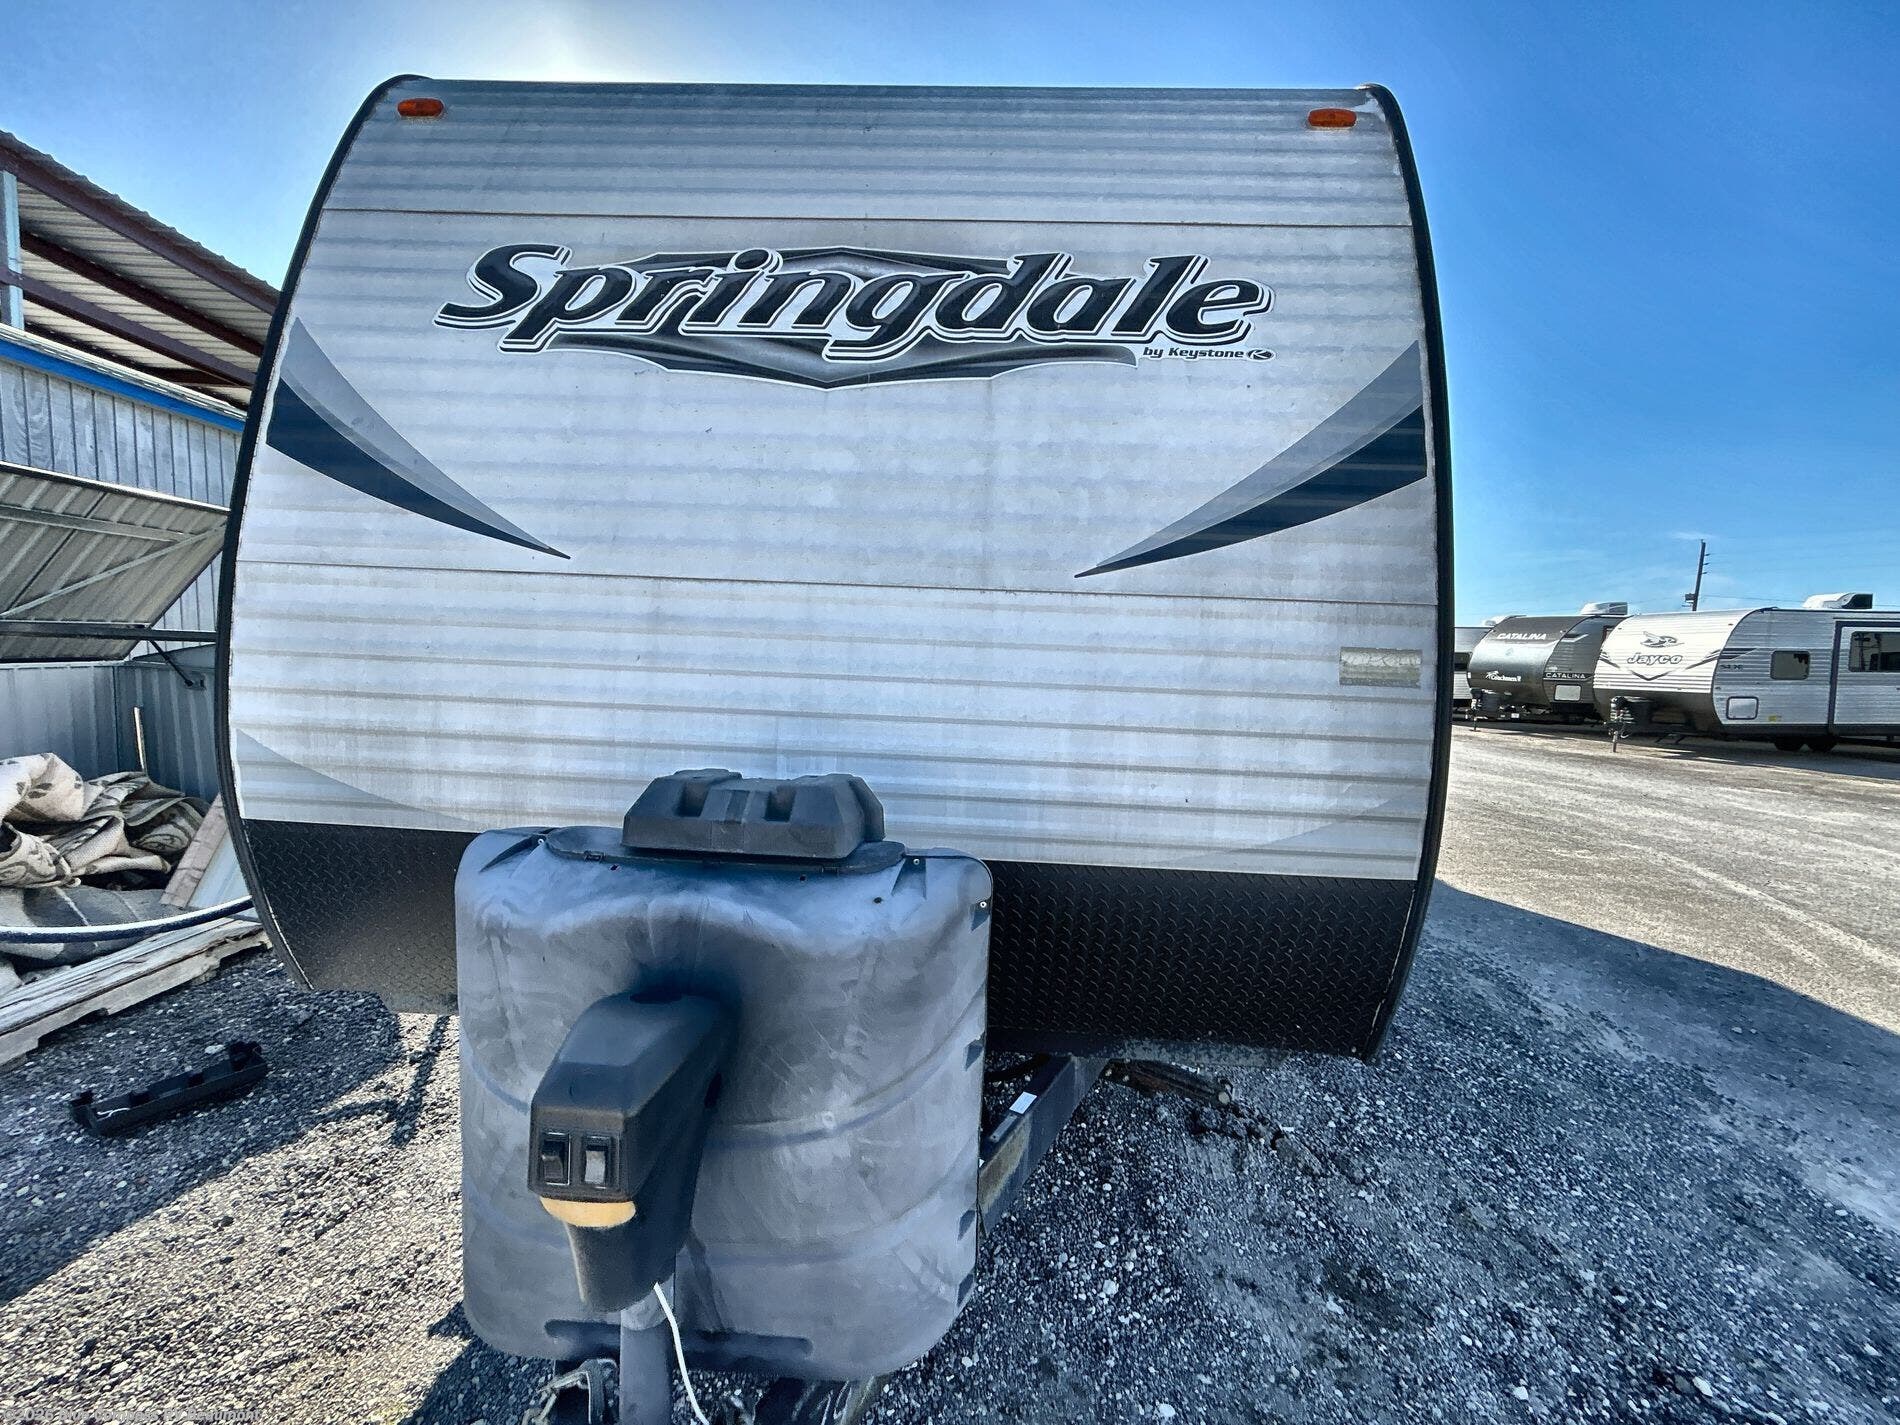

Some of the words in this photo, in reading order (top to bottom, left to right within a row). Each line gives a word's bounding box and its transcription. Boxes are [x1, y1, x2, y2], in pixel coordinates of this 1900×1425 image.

[435, 244, 1271, 361] Springdale
[1143, 347, 1163, 358] by
[1168, 347, 1244, 359] Keystone
[1627, 652, 1683, 665] Jayco
